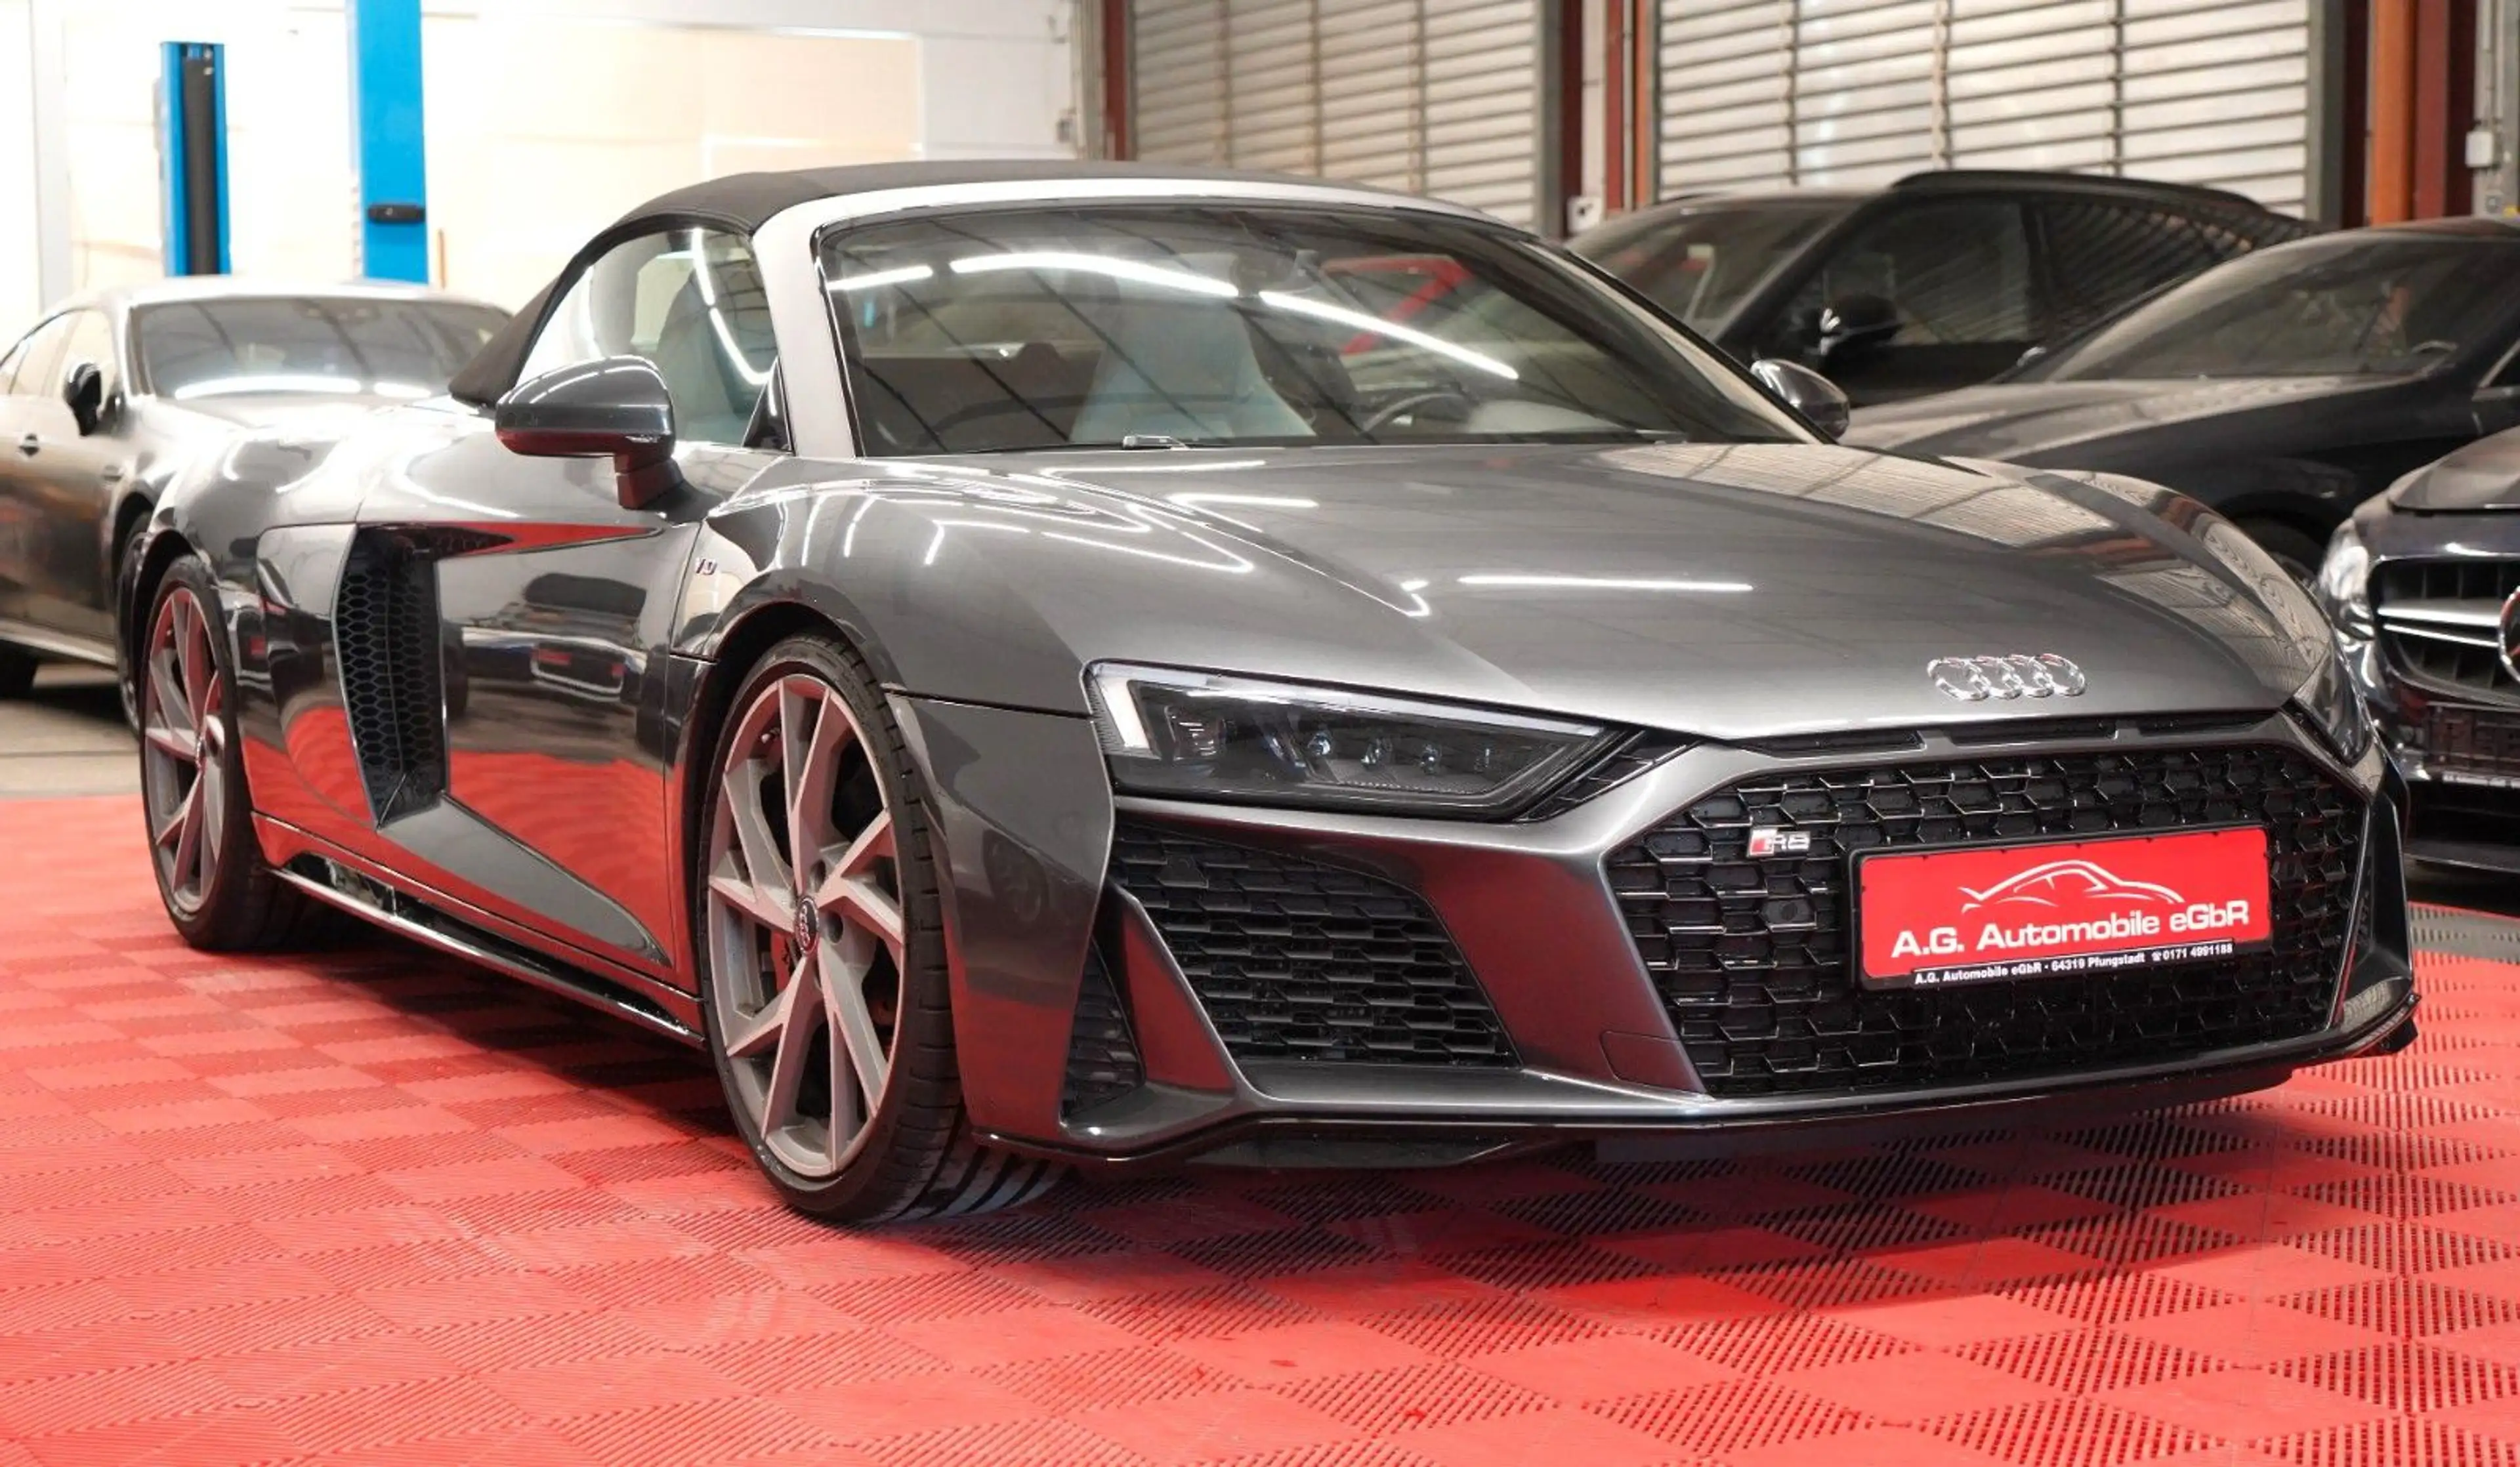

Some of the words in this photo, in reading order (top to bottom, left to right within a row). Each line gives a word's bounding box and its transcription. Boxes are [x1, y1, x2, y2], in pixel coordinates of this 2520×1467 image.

[1891, 927, 1965, 958] A.G.
[1976, 909, 2160, 951] Automobile
[2170, 899, 2250, 932] eGbR
[1915, 972, 1940, 984] A.G.
[1942, 966, 2009, 981] Automobile
[2011, 962, 2042, 976] eGbR
[2087, 952, 2145, 968] Pfungstadt
